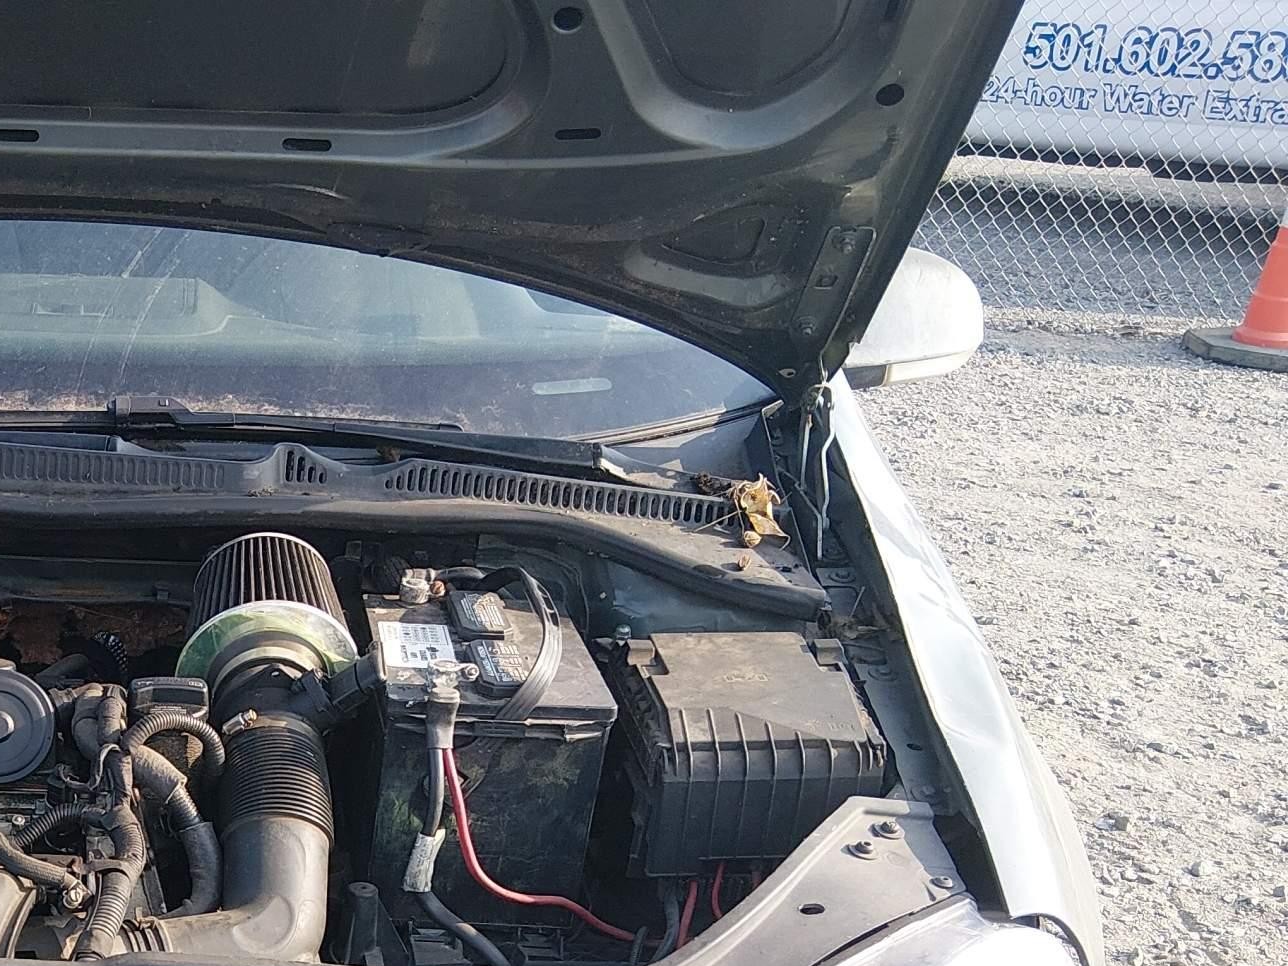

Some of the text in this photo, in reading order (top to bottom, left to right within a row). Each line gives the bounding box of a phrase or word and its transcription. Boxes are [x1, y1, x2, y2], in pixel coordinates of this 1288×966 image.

[1022, 21, 1288, 84] 501.602.58
[979, 75, 1097, 110] 24-hour
[1103, 83, 1198, 117] Water
